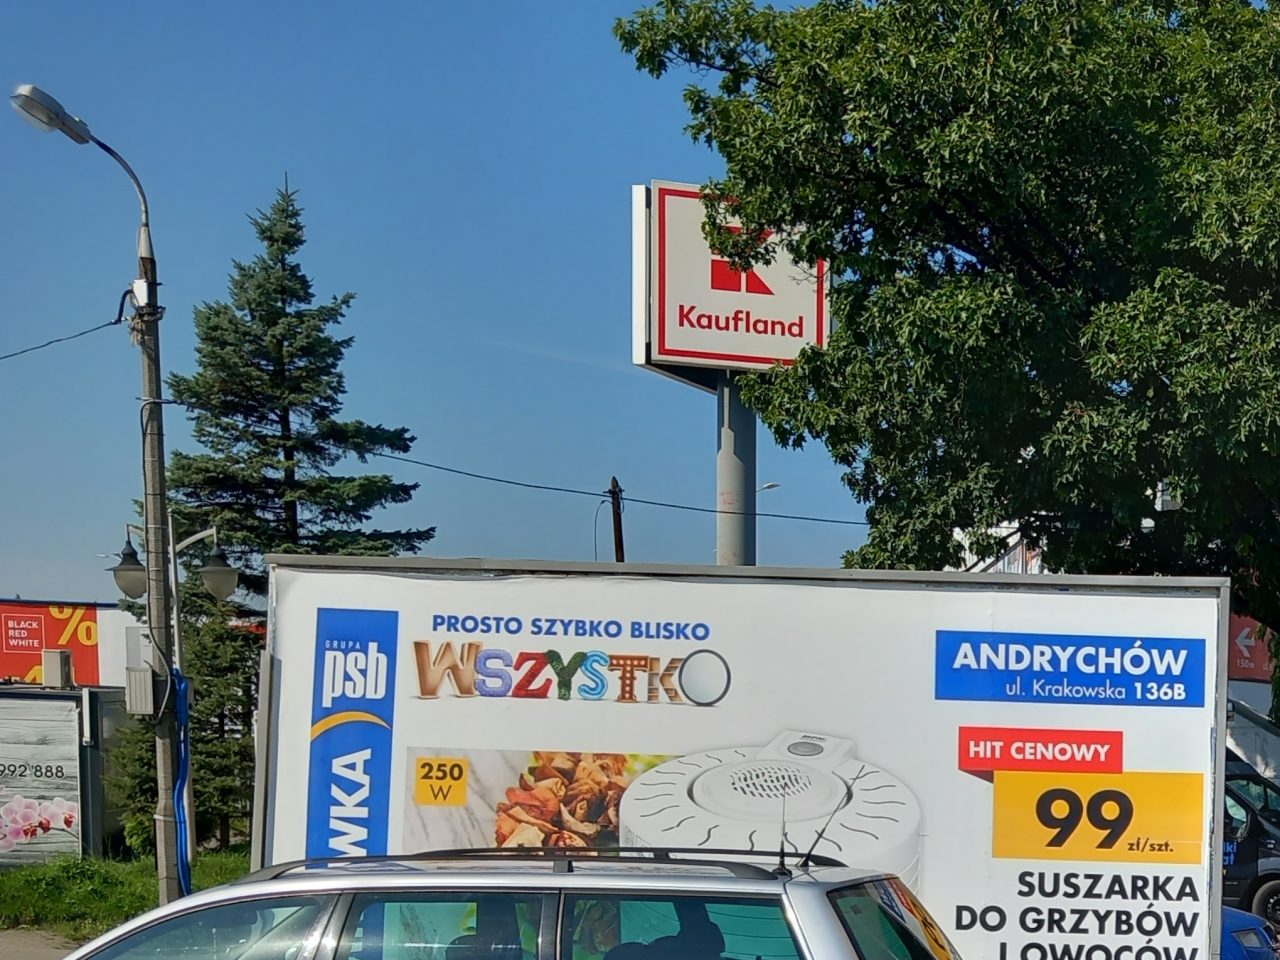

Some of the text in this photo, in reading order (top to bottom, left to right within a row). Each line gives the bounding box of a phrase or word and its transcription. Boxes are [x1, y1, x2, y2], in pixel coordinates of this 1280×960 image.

[678, 304, 804, 338] Kaufland
[8, 620, 39, 629] BLACK
[8, 629, 28, 638] RED
[432, 614, 710, 641] PROSTO SZYBKO BLISKO
[8, 639, 40, 648] WHITE
[325, 640, 361, 650] GRUPA
[952, 640, 1188, 676] ANDRYCHÓW
[322, 642, 388, 708] psb
[413, 640, 732, 707] WSZYSTKO
[1006, 676, 1187, 700] ul. Krakowska 136B
[969, 740, 1110, 762] HIT CENOWY
[33, 764, 65, 778] 888
[420, 762, 464, 781] 250
[430, 784, 452, 801] W
[1035, 788, 1174, 853] 99 zł/szt.
[1017, 871, 1200, 902] SUSZARKA
[955, 903, 1200, 937] DO GRZYBÓW
